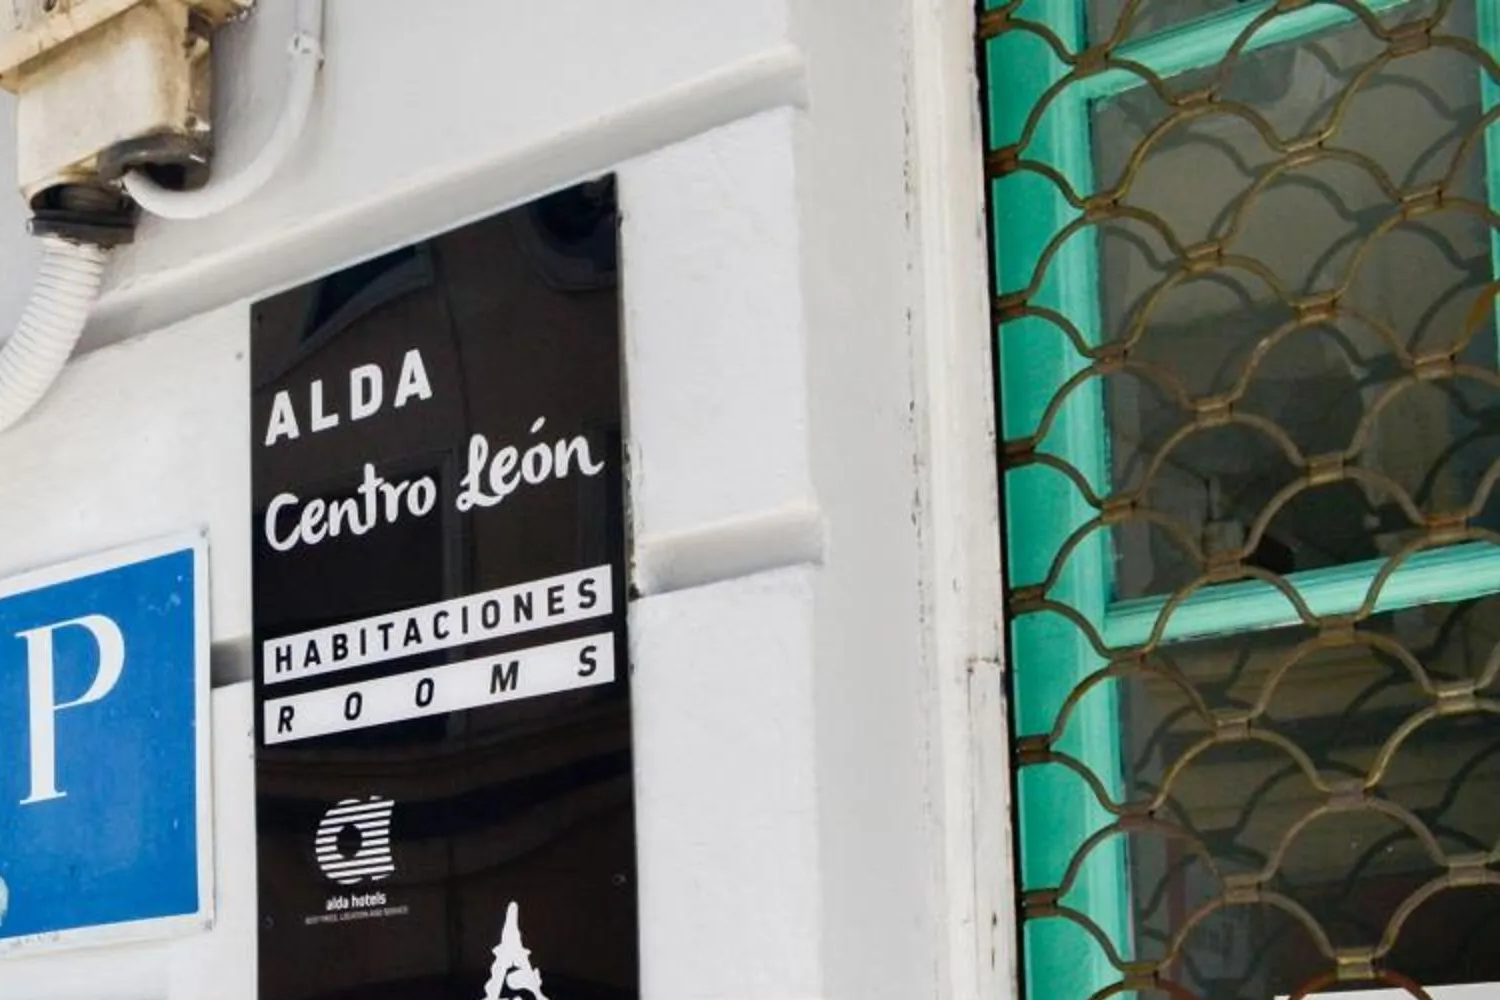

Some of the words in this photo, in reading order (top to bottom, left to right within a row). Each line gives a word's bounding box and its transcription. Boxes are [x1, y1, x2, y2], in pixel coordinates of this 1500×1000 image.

[265, 348, 433, 447] ALDA
[266, 462, 438, 552] Centro
[457, 416, 605, 513] León
[275, 577, 599, 675] HABITACIONES
[14, 613, 126, 806] P
[277, 645, 598, 736] ROOMS
[351, 891, 387, 908] hotels
